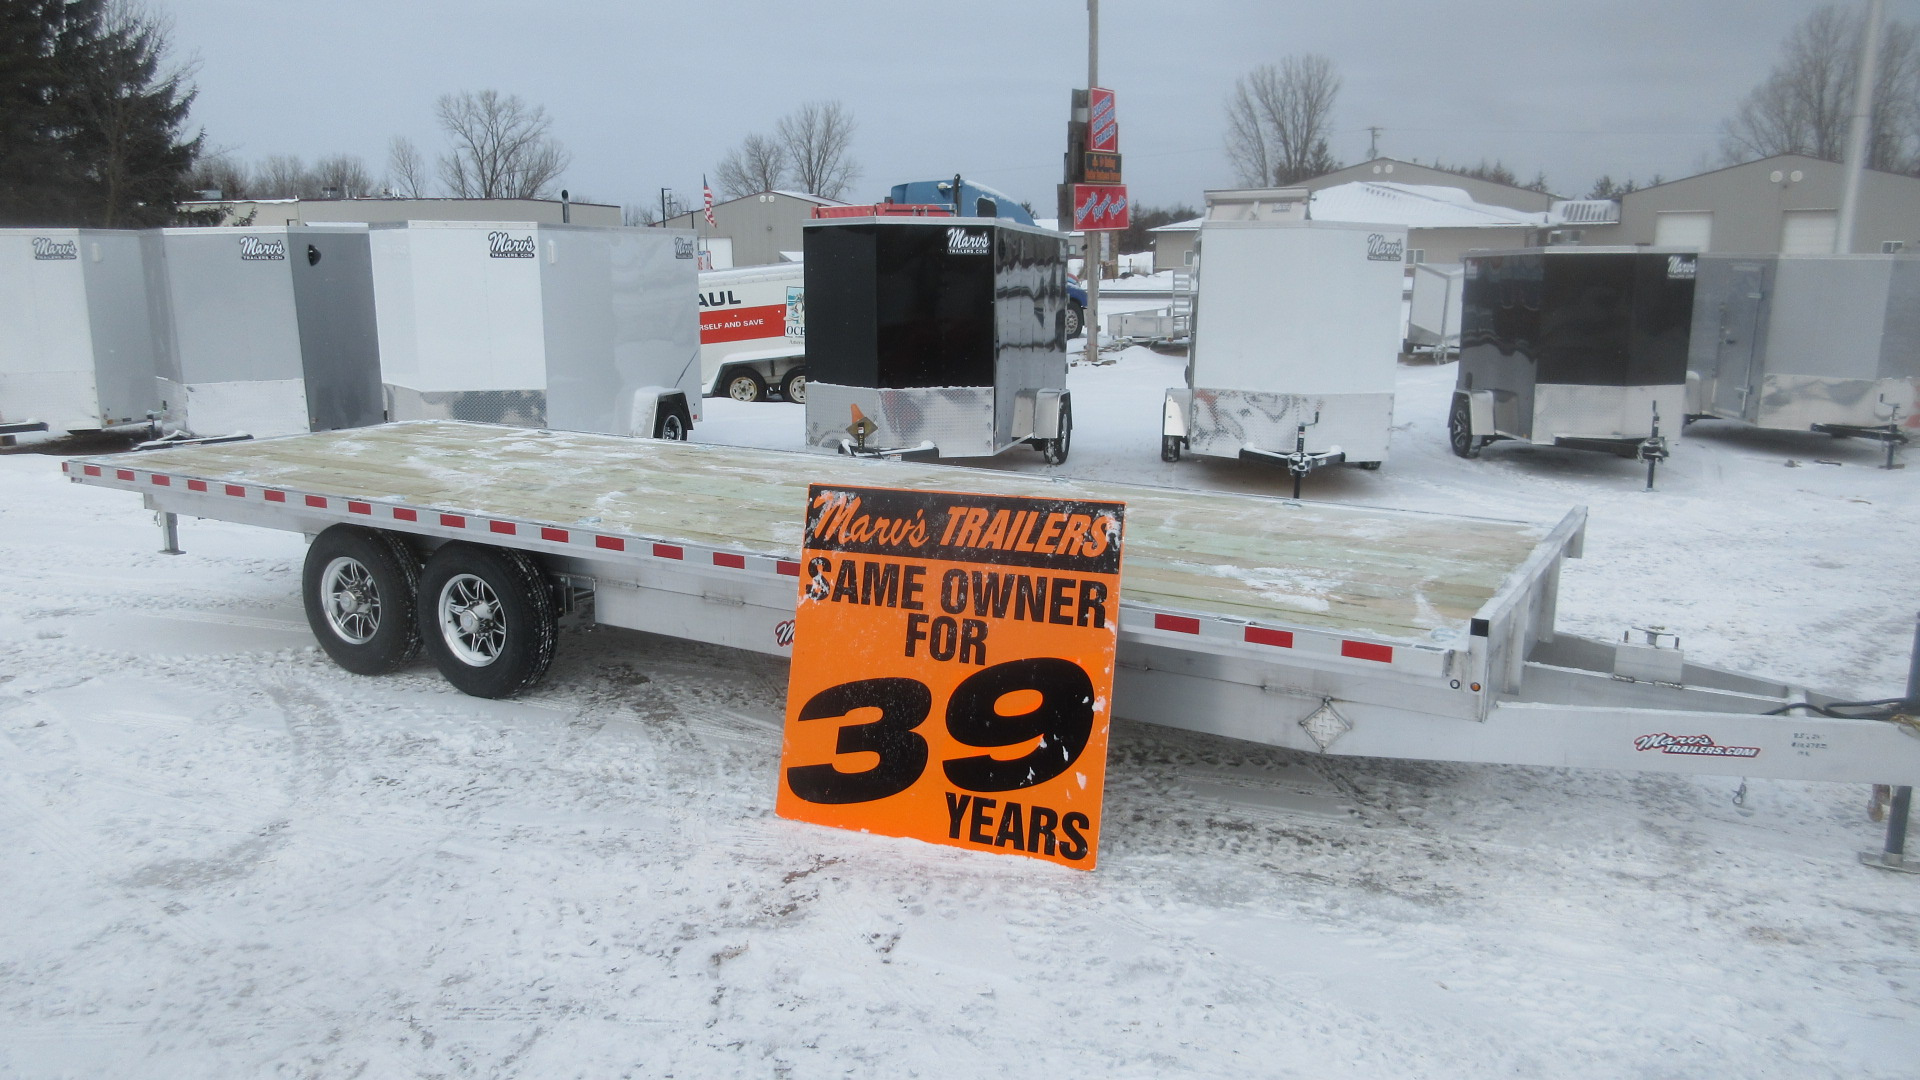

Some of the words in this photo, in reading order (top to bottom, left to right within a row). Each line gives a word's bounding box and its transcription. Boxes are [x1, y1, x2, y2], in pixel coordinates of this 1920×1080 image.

[32, 237, 77, 256] Marv's
[240, 236, 285, 255] Marv's
[488, 231, 535, 252] Marv's
[947, 228, 989, 249] Marv's
[1367, 234, 1402, 255] Marv's
[1667, 255, 1696, 273] Marv's
[724, 321, 741, 329] AND
[743, 319, 764, 327] SAVE
[814, 491, 930, 547] Marv's
[939, 505, 1110, 558] TRAILERS
[805, 556, 927, 610] SAME
[941, 569, 1107, 629] OWNER
[905, 613, 988, 666] FOR
[787, 657, 1095, 805] 39
[1635, 734, 1713, 750] Marv's
[1664, 744, 1756, 757] TRAILERS.COM
[945, 792, 1089, 860] YEARS
